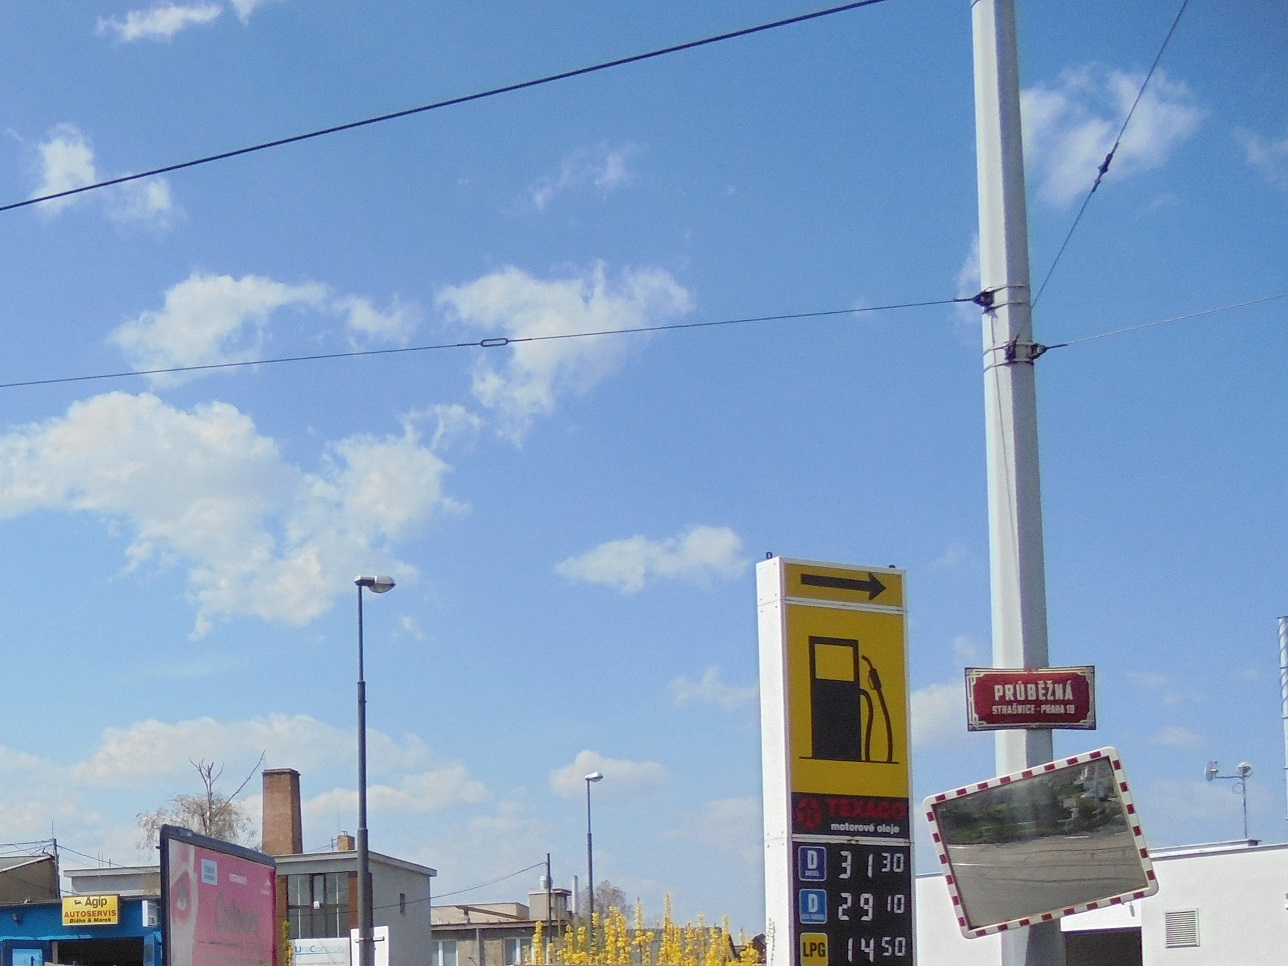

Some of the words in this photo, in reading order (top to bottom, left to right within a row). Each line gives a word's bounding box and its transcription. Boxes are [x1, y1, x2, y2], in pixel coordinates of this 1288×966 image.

[994, 680, 1074, 701] PRŮBĚŽNÁ
[992, 703, 1036, 715] STRAŠNICE
[1040, 704, 1065, 714] PRAHA
[1066, 704, 1075, 714] 10
[825, 798, 906, 819] TEXACO
[830, 822, 875, 833] motorové
[876, 823, 900, 835] oleje
[807, 850, 818, 869] D
[881, 852, 904, 872] 30
[87, 897, 108, 909] Agip
[808, 894, 818, 912] D
[886, 895, 905, 913] 10
[64, 910, 117, 918] AUTOSERVIS
[803, 942, 826, 957] LPG
[847, 937, 874, 962] 14
[881, 937, 905, 956] 50
